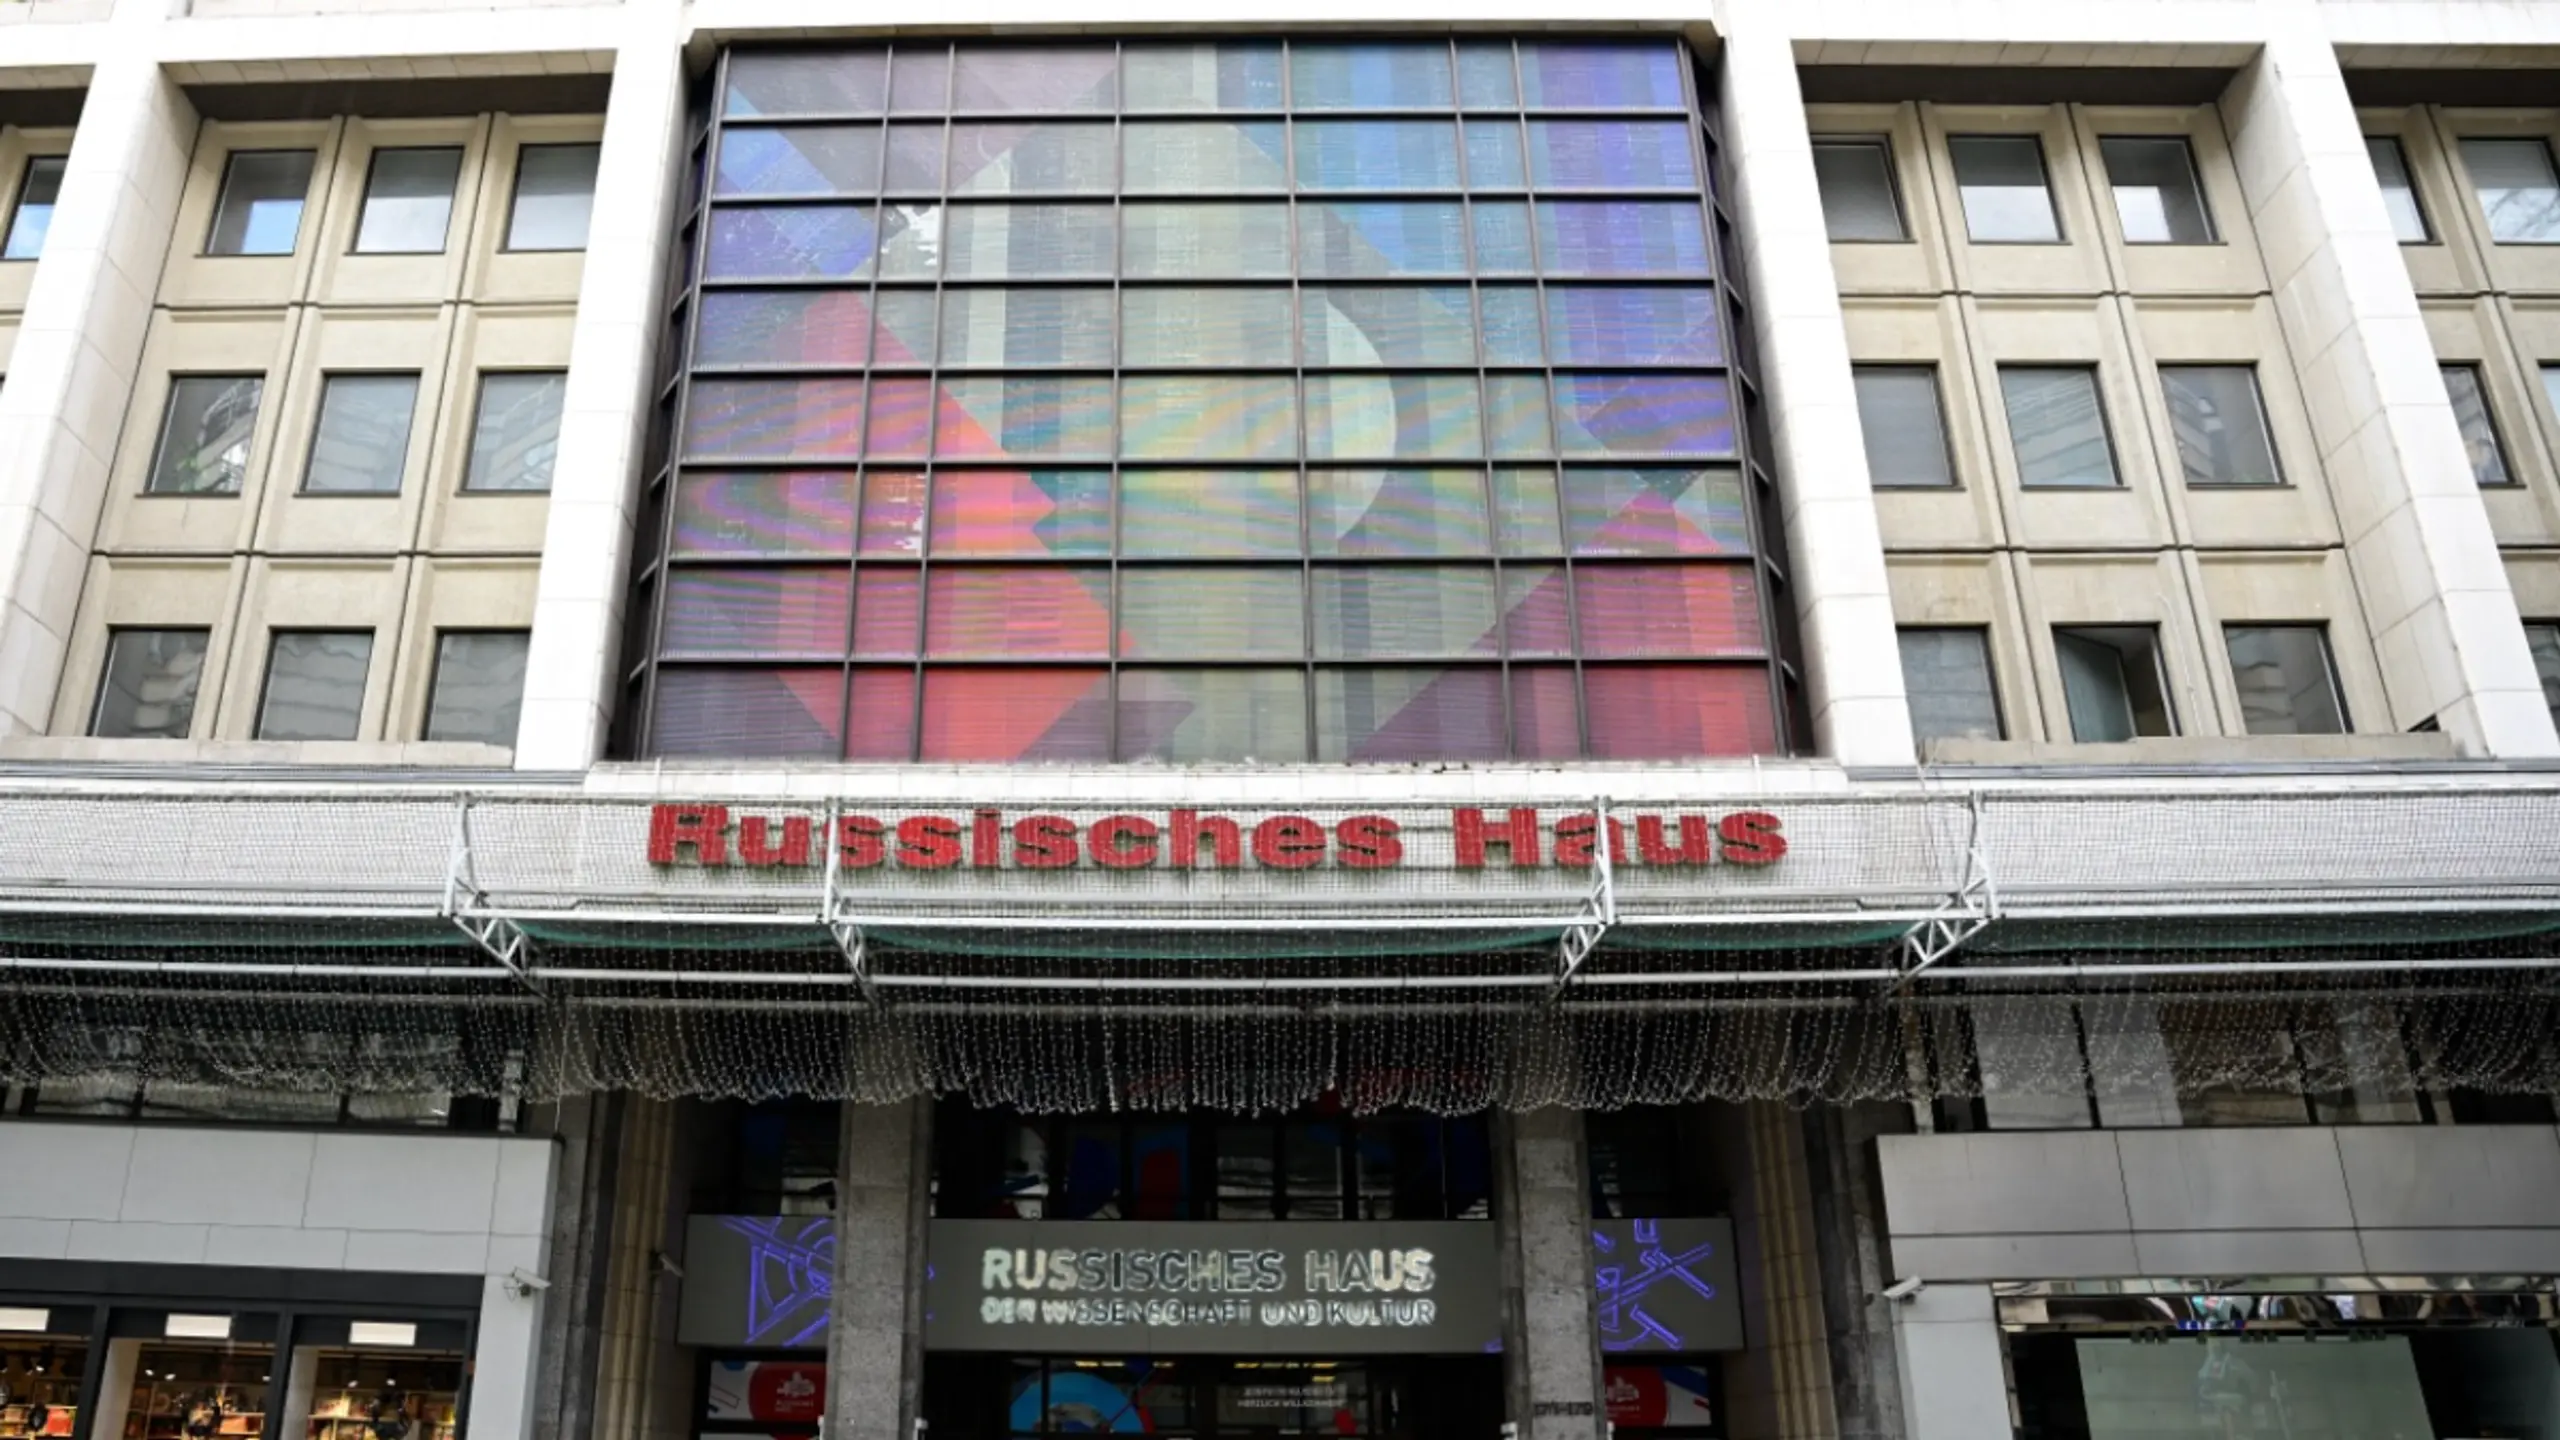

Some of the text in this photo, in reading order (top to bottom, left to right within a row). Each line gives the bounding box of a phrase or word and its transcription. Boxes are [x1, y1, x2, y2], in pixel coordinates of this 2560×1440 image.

[647, 803, 1788, 869] Russisches Haus
[981, 1247, 1436, 1292] RUSSISCHES HAUS
[981, 1297, 1437, 1327] DER WISSENSCHAFT UND KULTUR
